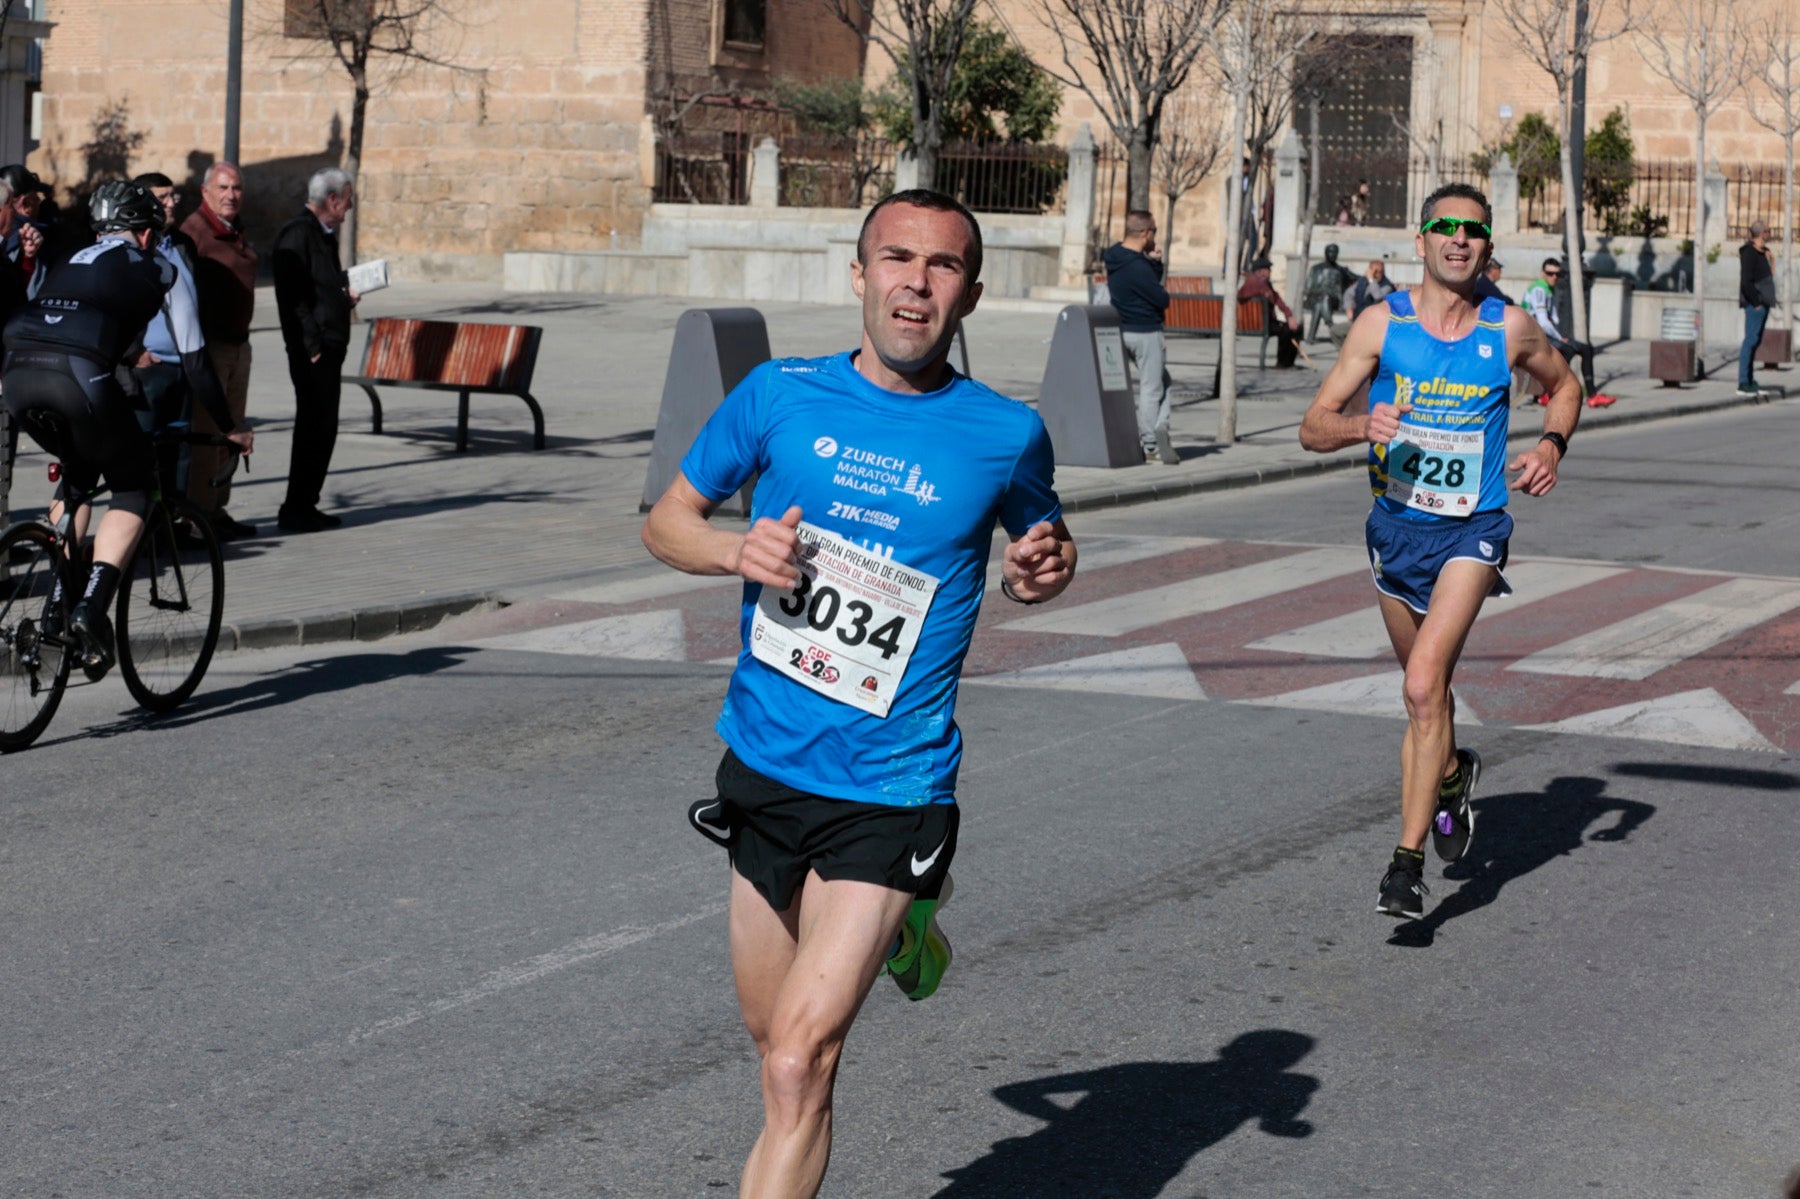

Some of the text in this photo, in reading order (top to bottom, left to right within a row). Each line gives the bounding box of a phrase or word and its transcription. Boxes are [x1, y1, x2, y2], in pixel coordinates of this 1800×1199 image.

[1418, 377, 1490, 401] olimpo
[1414, 396, 1461, 407] deportes
[1410, 412, 1434, 423] TRAIL
[1412, 430, 1427, 438] GRAN
[1429, 431, 1451, 441] PREMIO
[1452, 433, 1460, 441] DE
[841, 446, 906, 471] ZURICH
[1402, 452, 1466, 488] 428
[832, 473, 887, 496] MÁLAGA
[837, 461, 900, 485] MARATÓN
[827, 501, 865, 522] 21K
[864, 509, 901, 525] MEDIA
[818, 536, 845, 558] GRAN
[845, 549, 880, 574] PREMIO
[880, 565, 893, 579] DE
[893, 570, 926, 592] FONDO
[852, 567, 863, 582] DE
[864, 573, 902, 597] GRANADA
[779, 571, 907, 660] 3034
